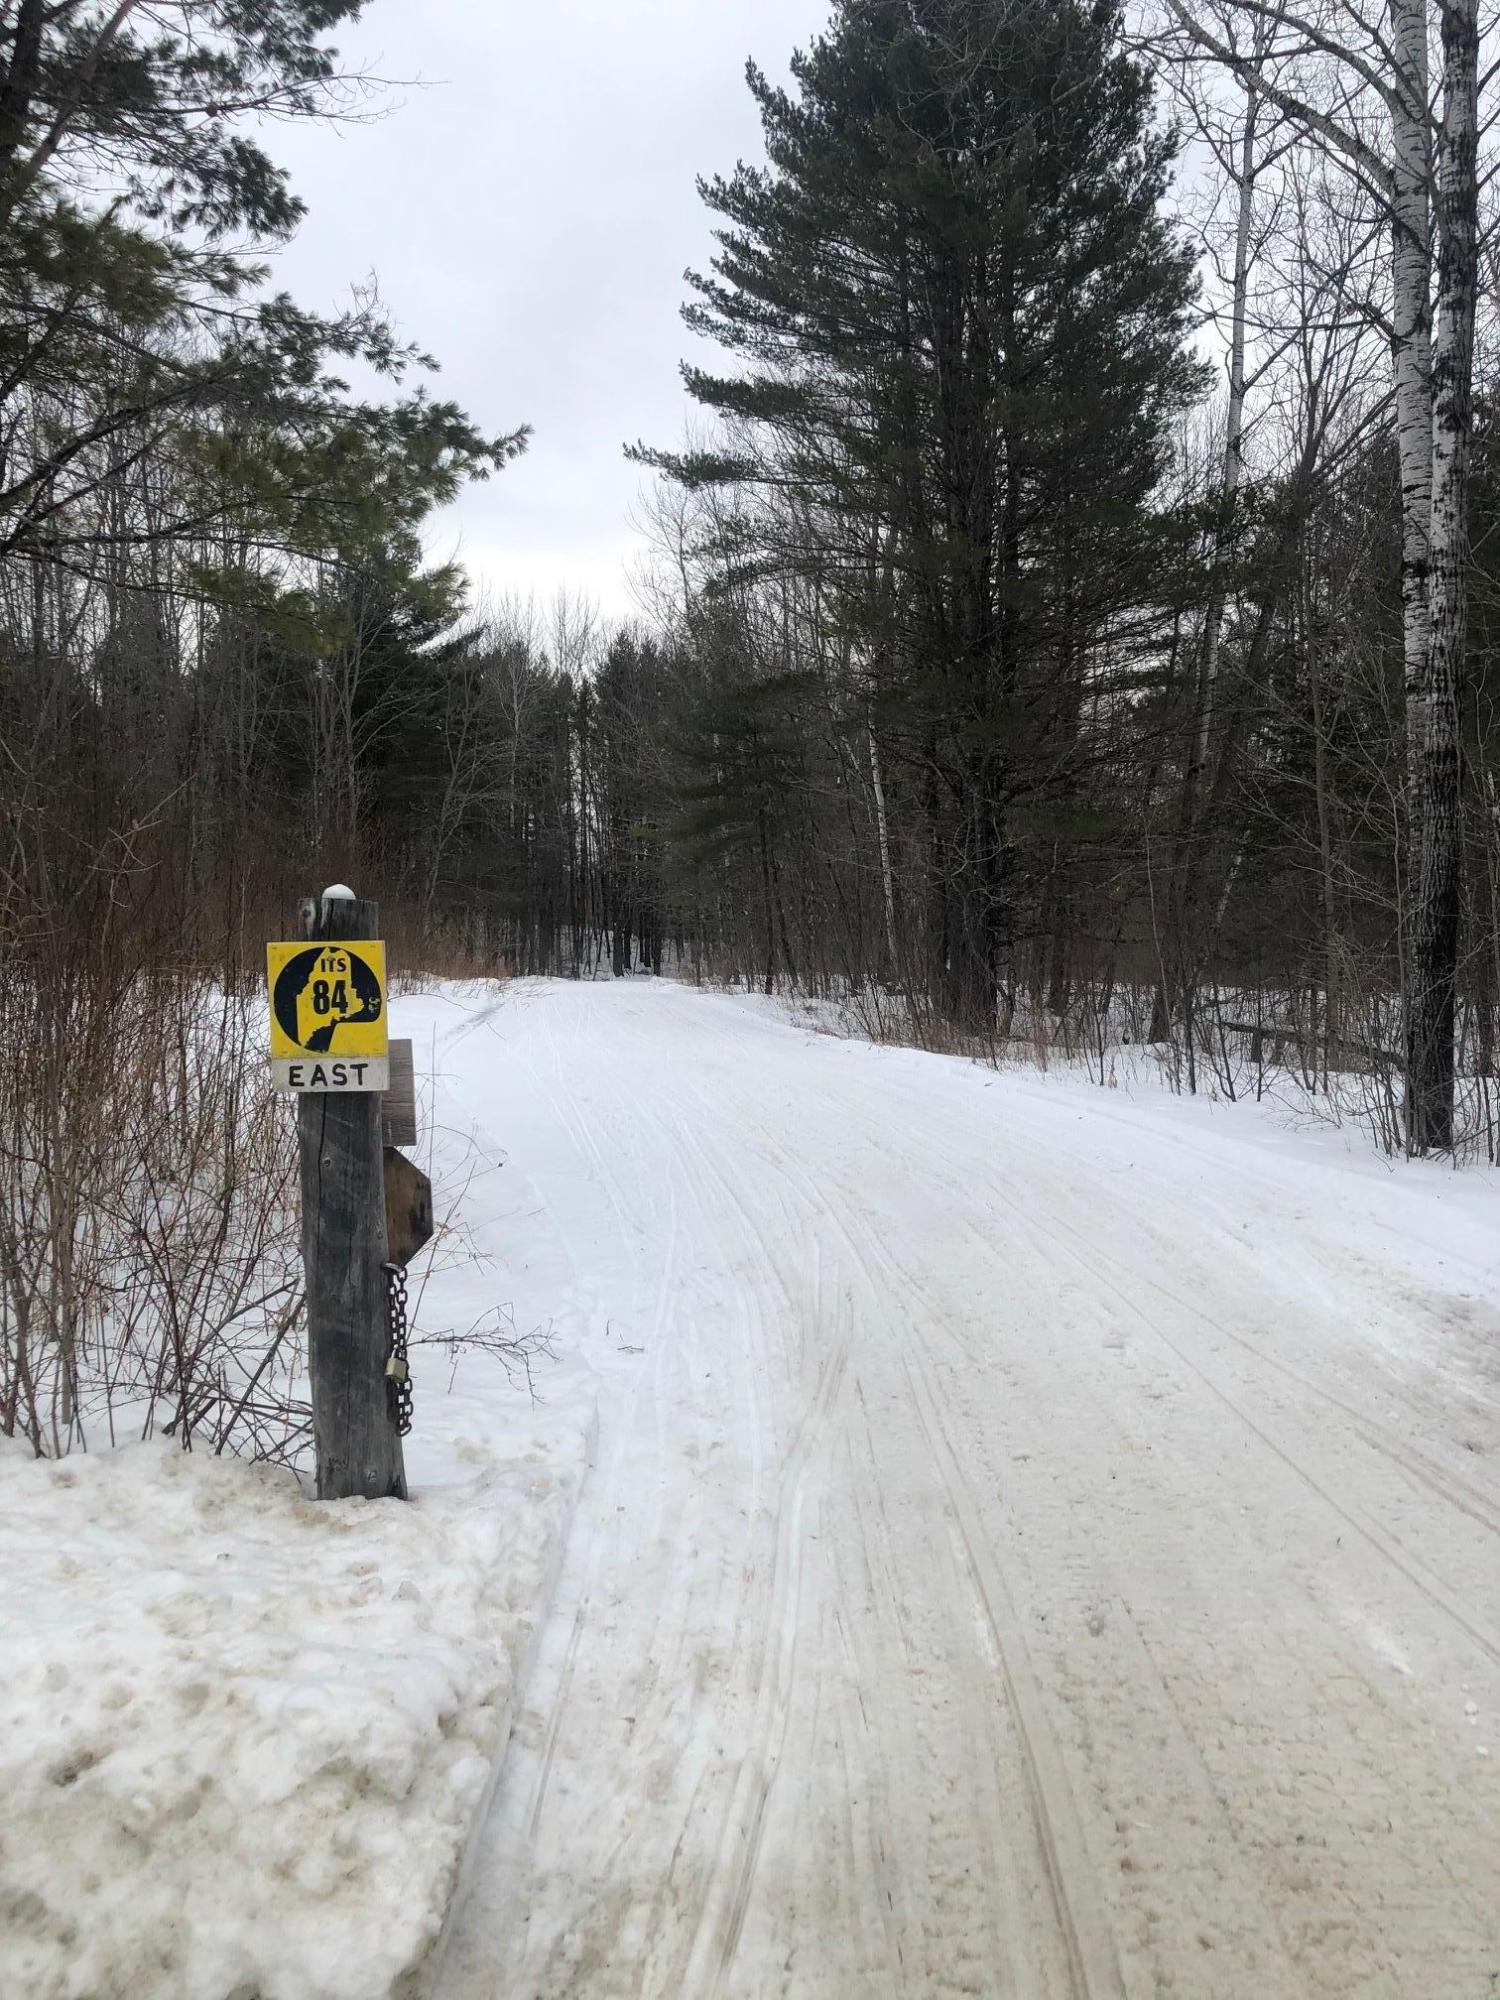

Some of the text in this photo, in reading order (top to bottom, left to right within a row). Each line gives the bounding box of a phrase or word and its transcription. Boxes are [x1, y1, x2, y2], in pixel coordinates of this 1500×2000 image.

[321, 958, 347, 973] ITS
[313, 980, 348, 1015] 84
[289, 1063, 368, 1087] EAST
